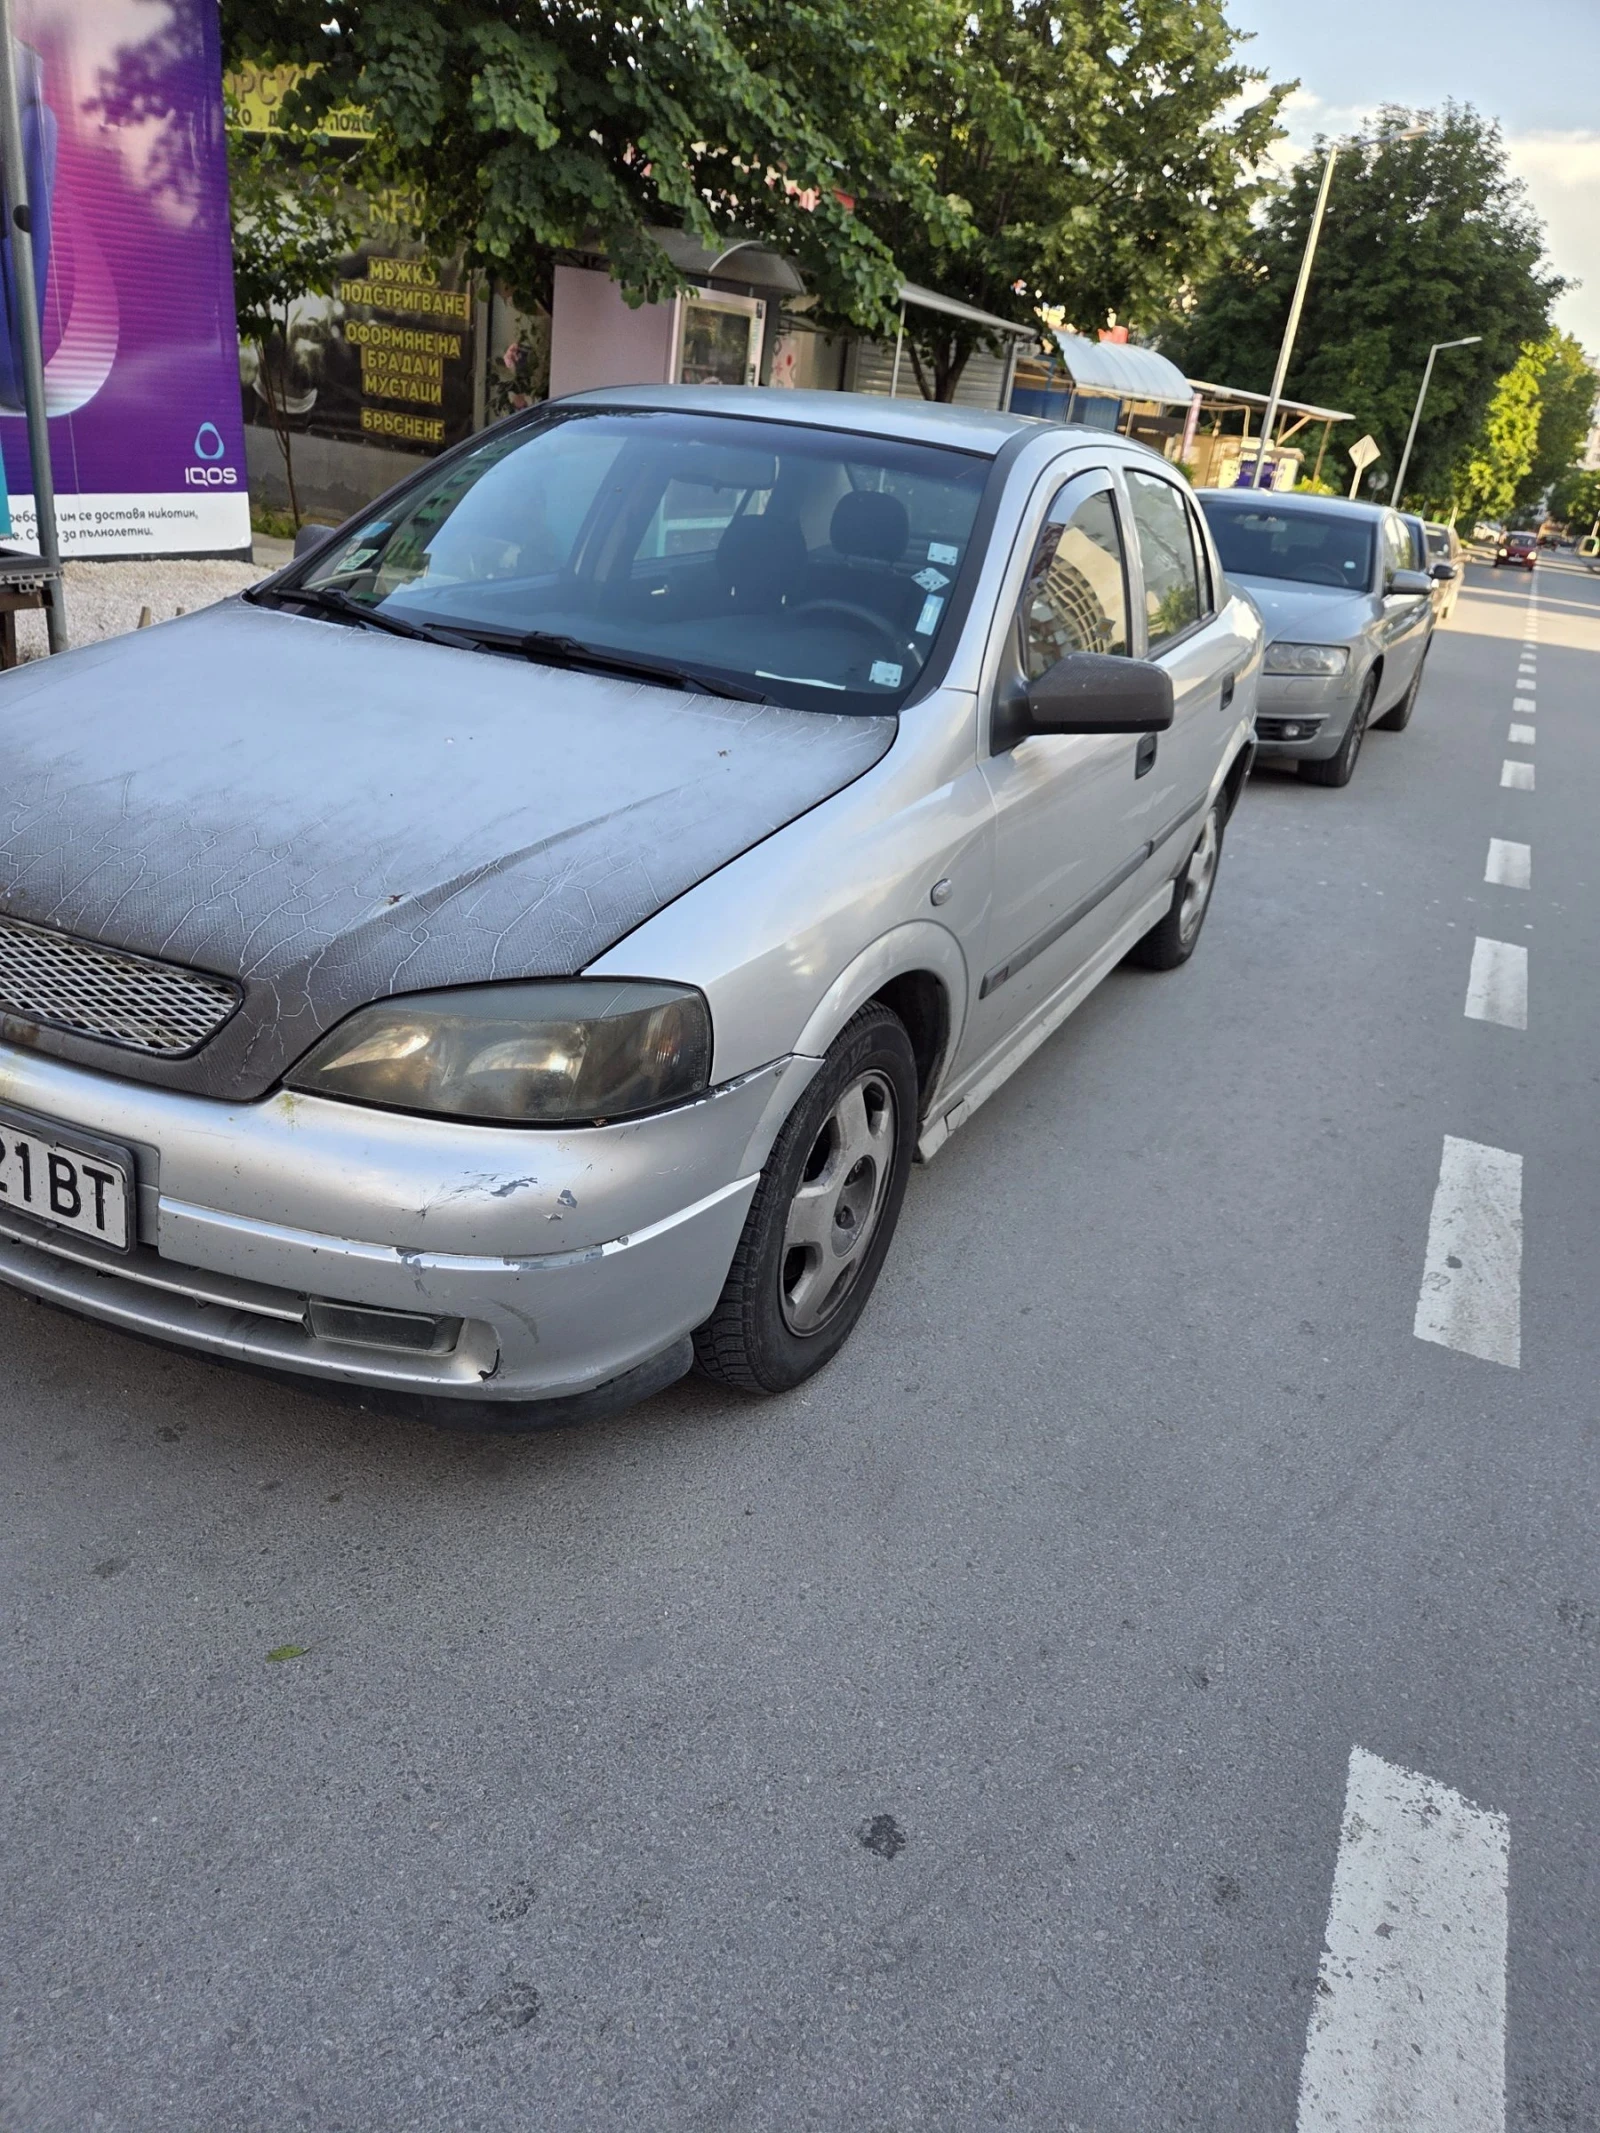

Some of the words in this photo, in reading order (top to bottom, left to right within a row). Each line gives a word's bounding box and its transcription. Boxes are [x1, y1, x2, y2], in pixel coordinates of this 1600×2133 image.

[341, 282, 466, 316] ПОДСТРИГВАНЕ
[345, 322, 435, 353] ОФОРМЯНЕ
[439, 336, 461, 357] НА
[367, 349, 424, 375] БРАДА
[428, 359, 440, 378] И
[364, 373, 442, 405] МУСТАЦИ
[362, 409, 444, 441] БРЪСНЕНЕ
[185, 467, 238, 486] IQOS
[60, 512, 76, 521] им
[79, 512, 92, 520] се
[94, 507, 146, 524] доставя
[63, 530, 76, 543] за
